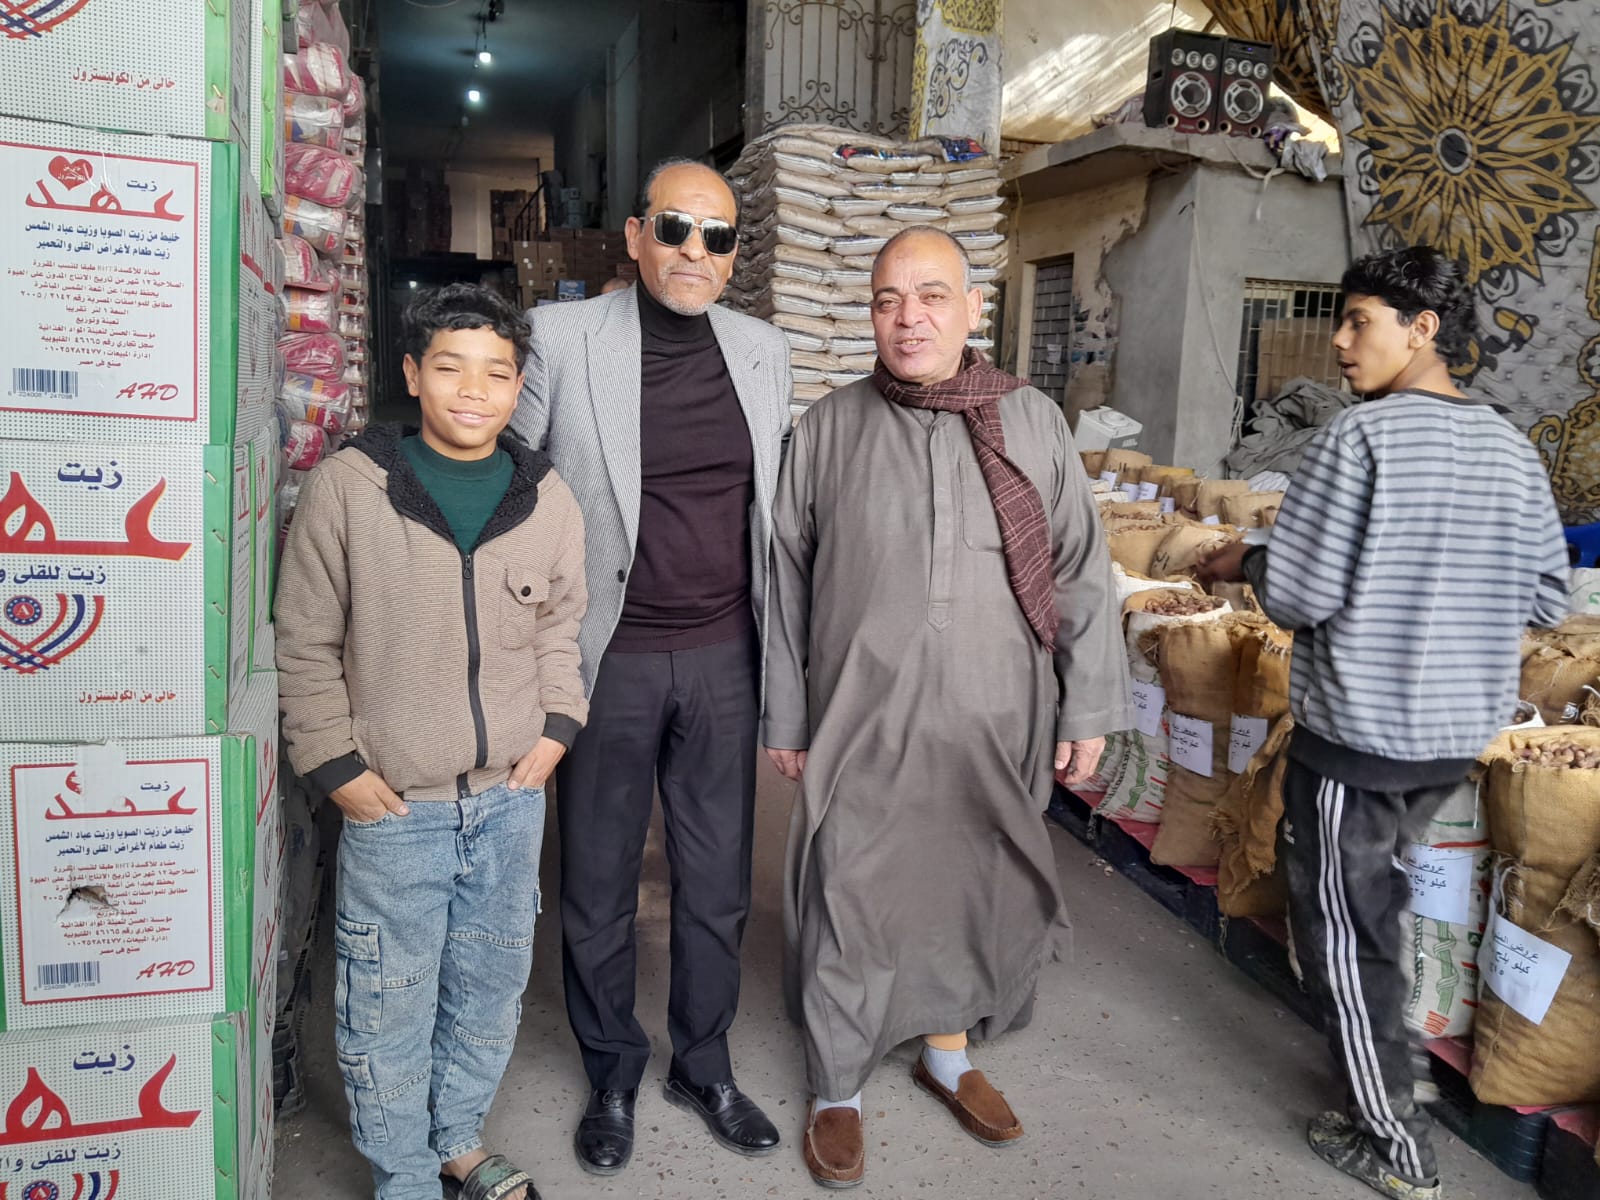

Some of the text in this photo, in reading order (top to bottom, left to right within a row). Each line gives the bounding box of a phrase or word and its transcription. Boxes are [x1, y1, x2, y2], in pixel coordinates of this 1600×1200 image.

[73, 66, 134, 85] الكوليسترول
[137, 75, 150, 89] من
[126, 178, 158, 192] زيت
[25, 179, 185, 222] عهد
[25, 221, 54, 232] الشمس
[57, 224, 74, 235] عباد
[76, 224, 98, 237] وزيت
[128, 229, 145, 242] زيت
[146, 231, 158, 242] من
[160, 231, 181, 244] خليط
[36, 239, 72, 252] والتحمير
[132, 246, 152, 257] طعام
[154, 247, 171, 260] زيت
[93, 275, 113, 284] تاريخ
[115, 382, 179, 401] AHD
[57, 460, 123, 490] زيت
[0, 471, 193, 561] عه
[13, 564, 61, 584] للقلى
[67, 565, 107, 585] زيت
[78, 690, 137, 704] الكوليسترول
[140, 691, 152, 703] من
[140, 780, 171, 792] زيت
[45, 830, 73, 843] الشمس
[75, 830, 92, 841] عباد
[94, 829, 115, 841] وزيت
[143, 826, 160, 838] زيت
[161, 825, 173, 837] من
[174, 824, 194, 836] خليط
[56, 844, 91, 857] والتحمير
[148, 841, 167, 853] طعام
[169, 840, 185, 851] زيت
[112, 871, 131, 880] تاريخ
[136, 959, 196, 981] AHD
[1510, 961, 1531, 975] كيلو
[73, 1044, 136, 1075] زيت
[0, 1053, 202, 1146] عه
[84, 1142, 121, 1162] زيت
[31, 1148, 76, 1170] للقلى
